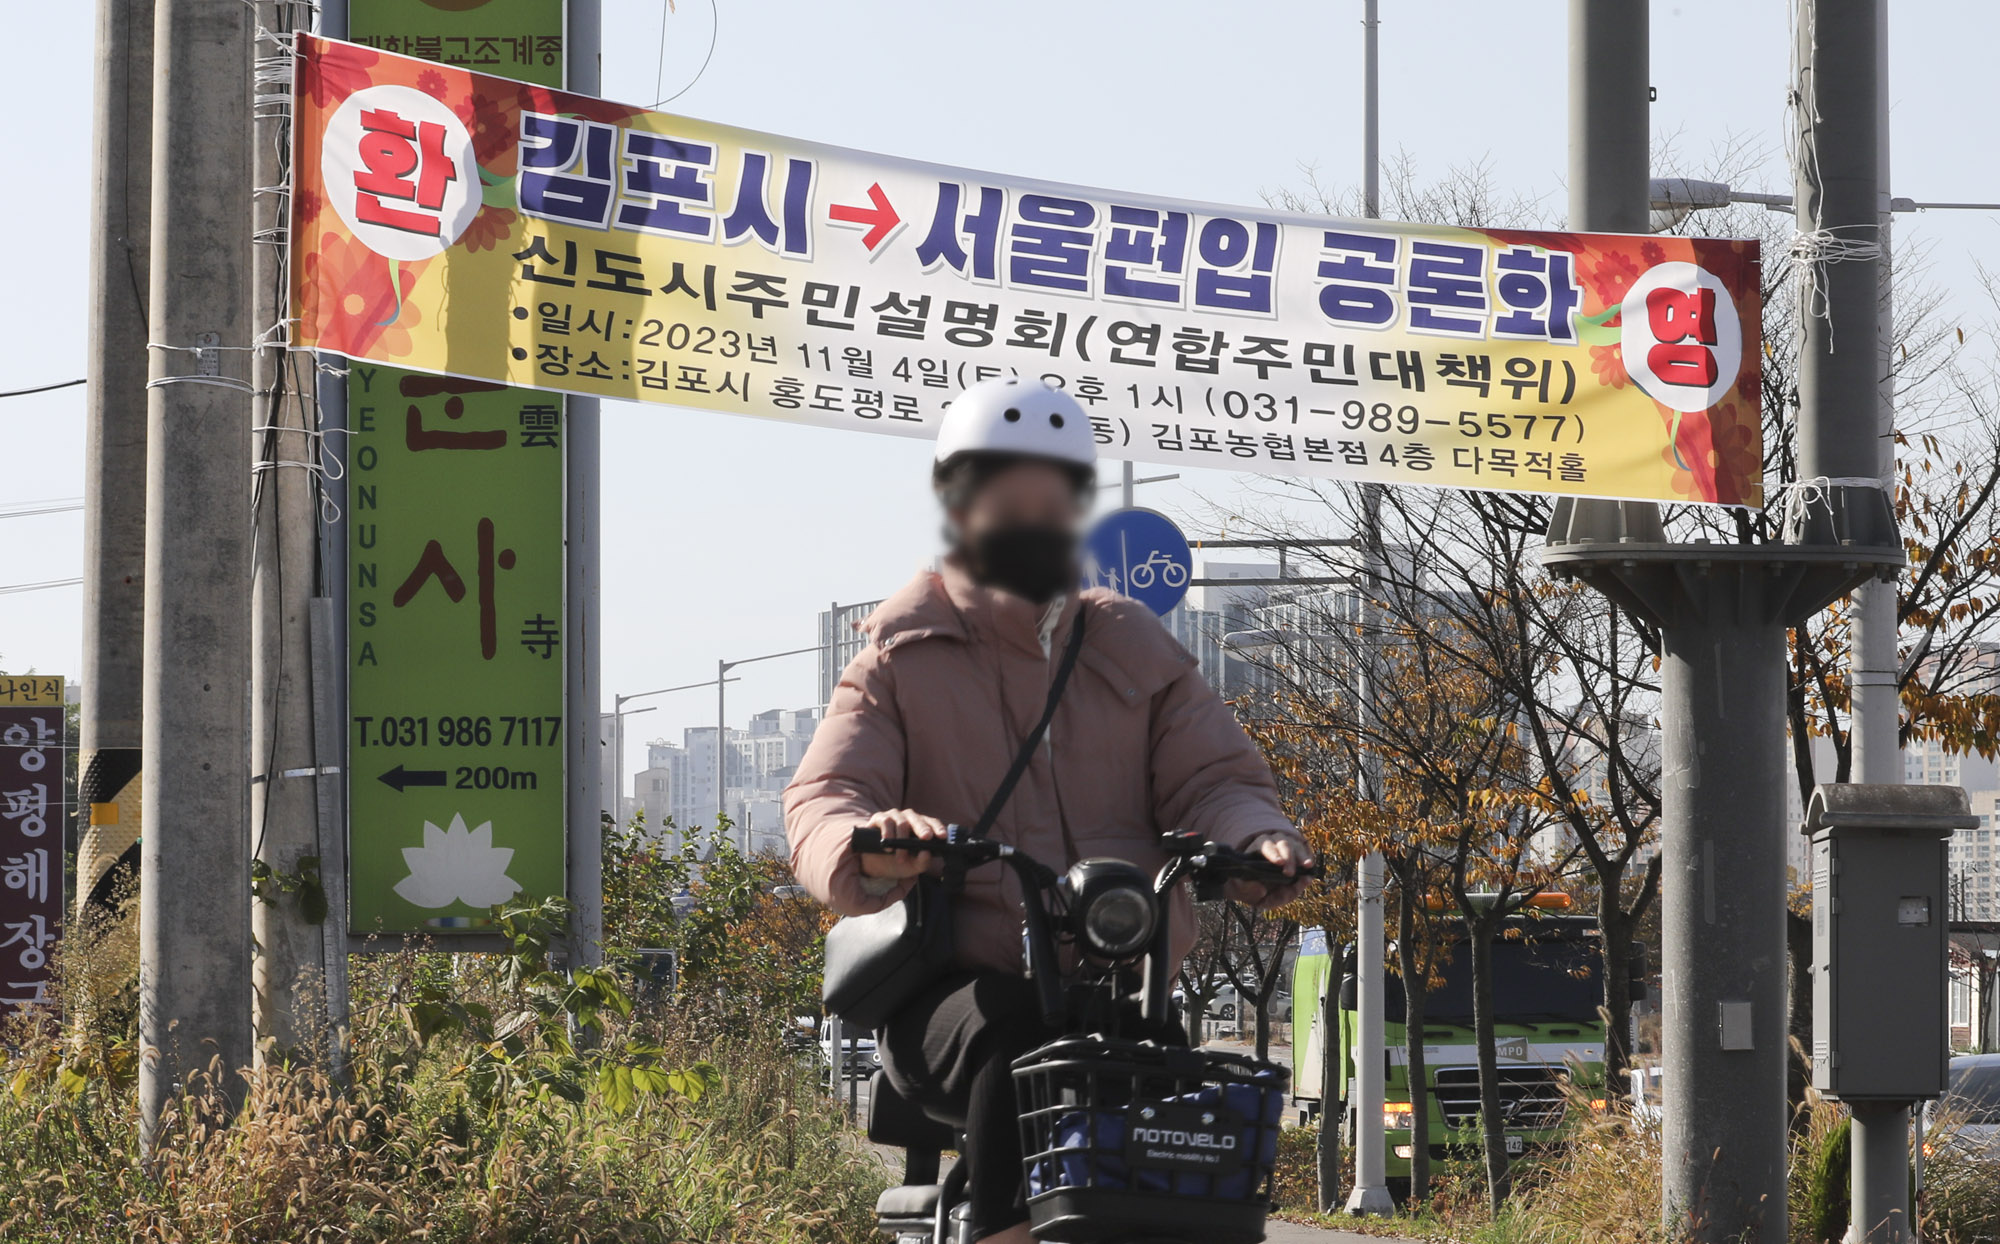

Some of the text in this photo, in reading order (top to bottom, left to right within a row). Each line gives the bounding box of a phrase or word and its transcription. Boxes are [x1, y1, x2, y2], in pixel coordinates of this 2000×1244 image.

[354, 108, 457, 238] 환
[517, 112, 1580, 341] 김포시 서울편입 공론화
[1645, 286, 1718, 388] 영
[769, 376, 924, 423] 홍도평로
[1452, 446, 1588, 483] 다목적홀
[797, 342, 874, 380] 11월
[1127, 383, 1183, 415] 1시
[1205, 386, 1585, 444] (031-989-5577)
[357, 367, 378, 667] YEONUNSA
[353, 715, 562, 748] T.031 986 7117
[455, 765, 538, 790] 200m
